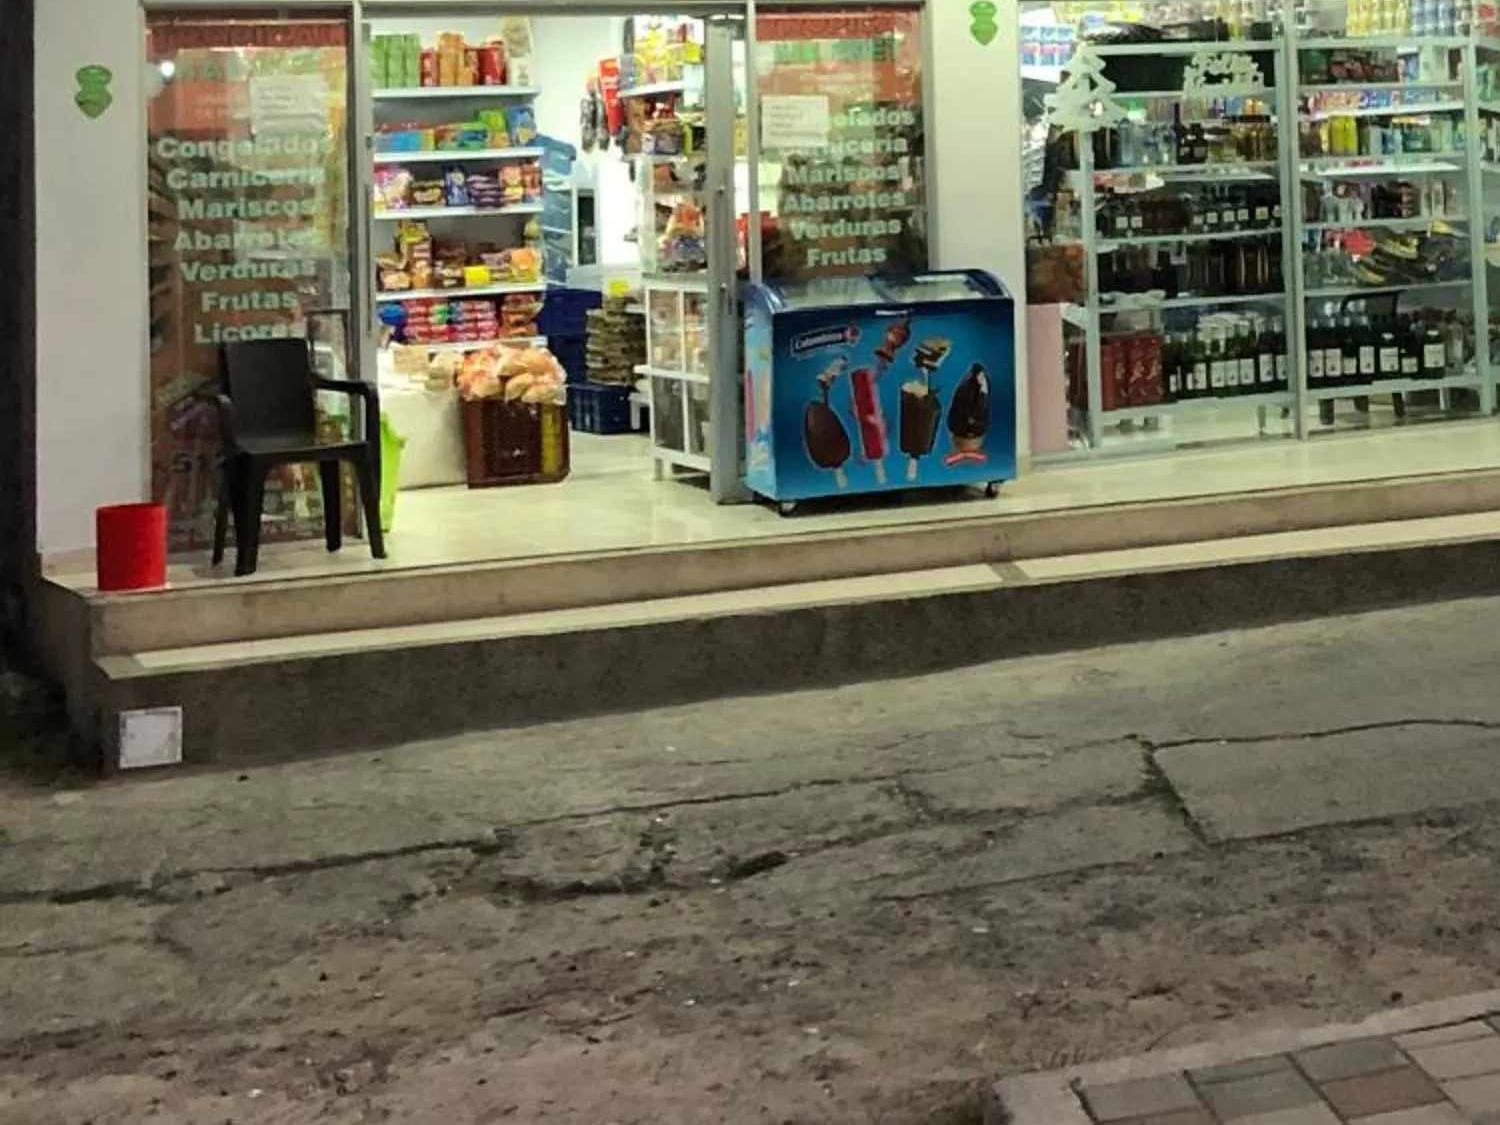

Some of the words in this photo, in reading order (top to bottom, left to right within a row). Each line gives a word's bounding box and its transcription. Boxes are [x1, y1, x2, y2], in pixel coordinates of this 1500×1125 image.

[786, 162, 902, 184] Mariscos
[176, 197, 319, 220] Mariscos
[784, 191, 905, 213] Abarrotes
[790, 218, 902, 240] Verduras
[806, 246, 887, 268] Frutas
[180, 258, 317, 282] Verduras
[201, 290, 298, 313] Frutas
[193, 322, 307, 344] Licores
